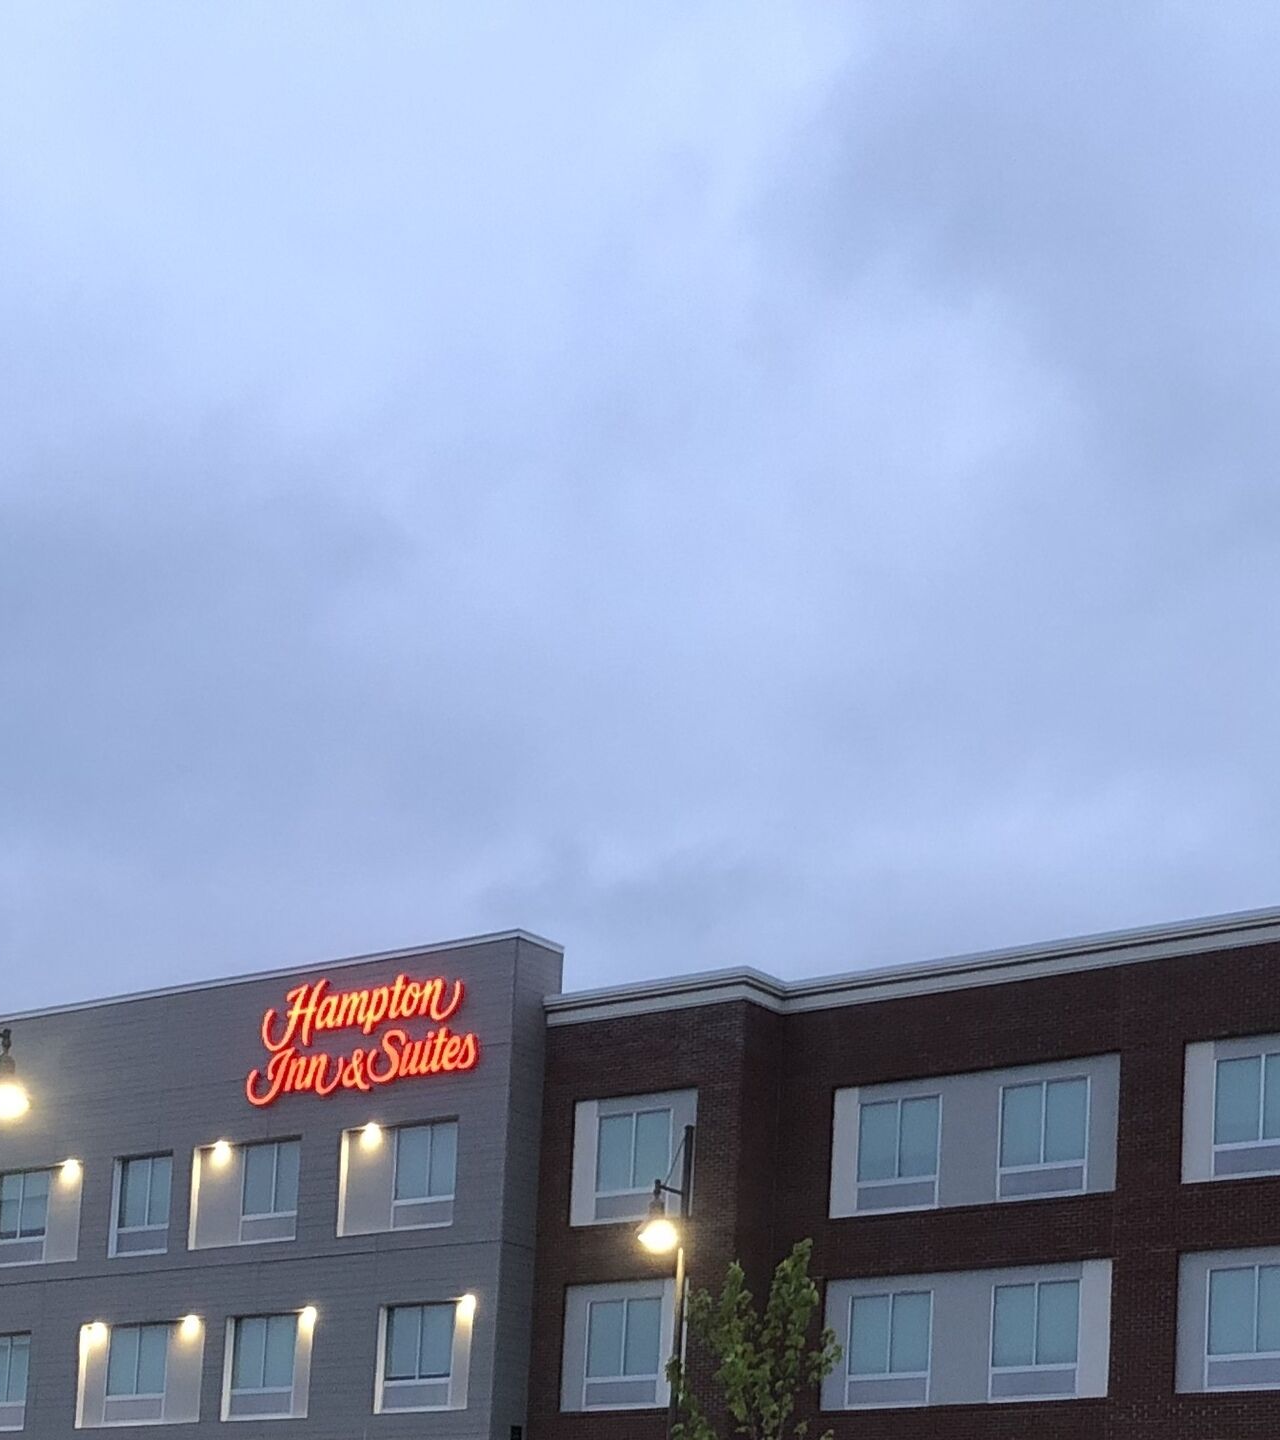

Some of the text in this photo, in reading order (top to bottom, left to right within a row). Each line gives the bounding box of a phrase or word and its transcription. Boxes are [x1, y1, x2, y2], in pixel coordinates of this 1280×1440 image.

[261, 973, 463, 1052] Hampton
[246, 1026, 478, 1106] Inn & Suites
